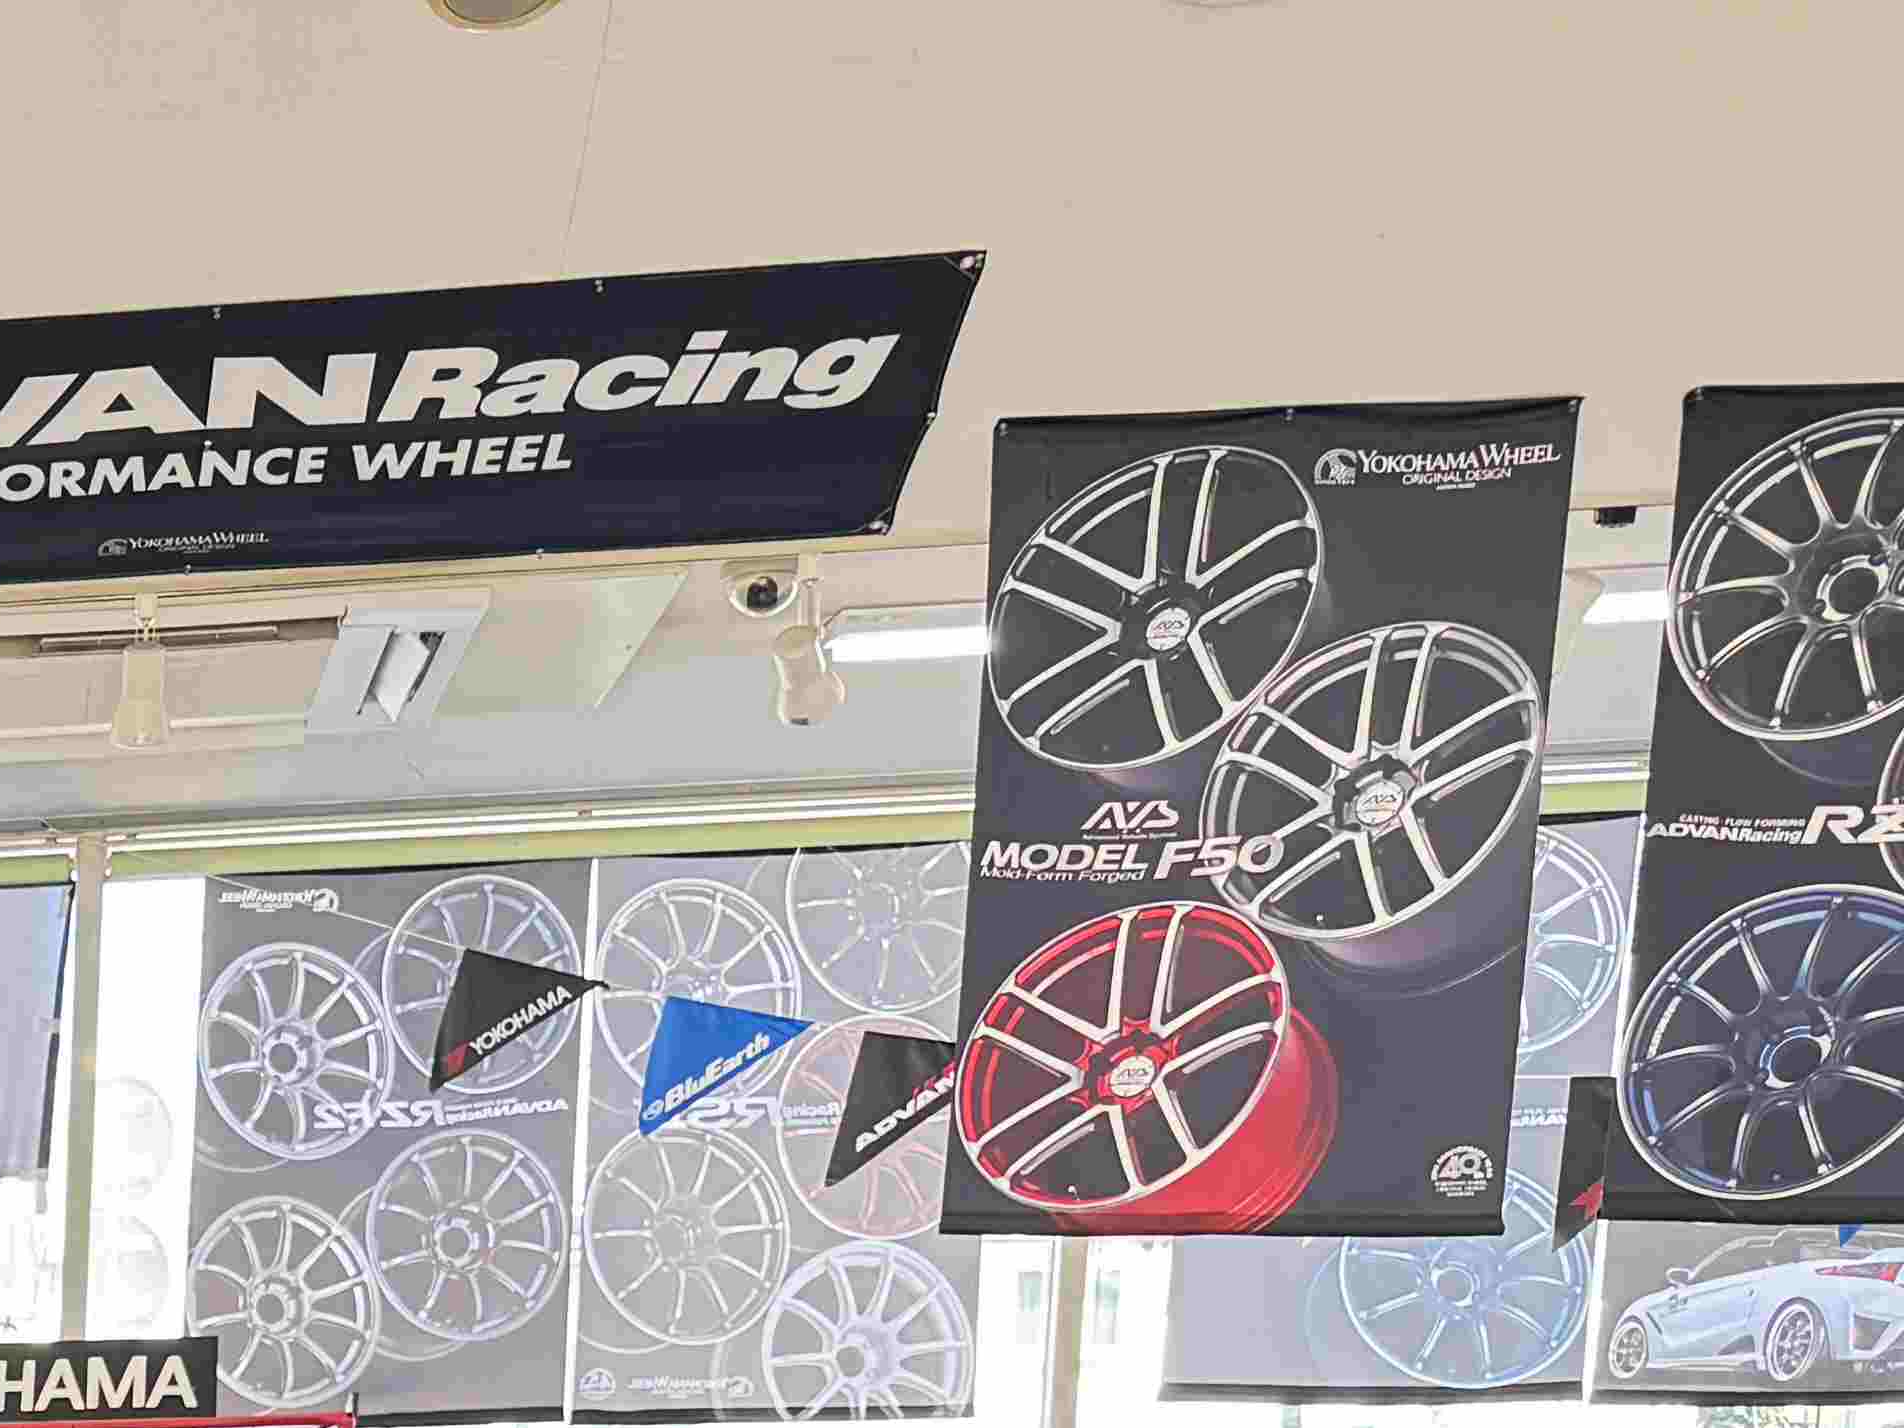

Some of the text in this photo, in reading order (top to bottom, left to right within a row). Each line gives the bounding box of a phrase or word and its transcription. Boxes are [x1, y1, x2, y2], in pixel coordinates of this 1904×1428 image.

[354, 429, 575, 482] WHEEL
[1357, 442, 1561, 474] YOKOHAMA WHEEL
[980, 835, 1285, 881] MODEL F50
[467, 984, 573, 1057] YOKOHAMA
[854, 1070, 957, 1153] ADVAN
